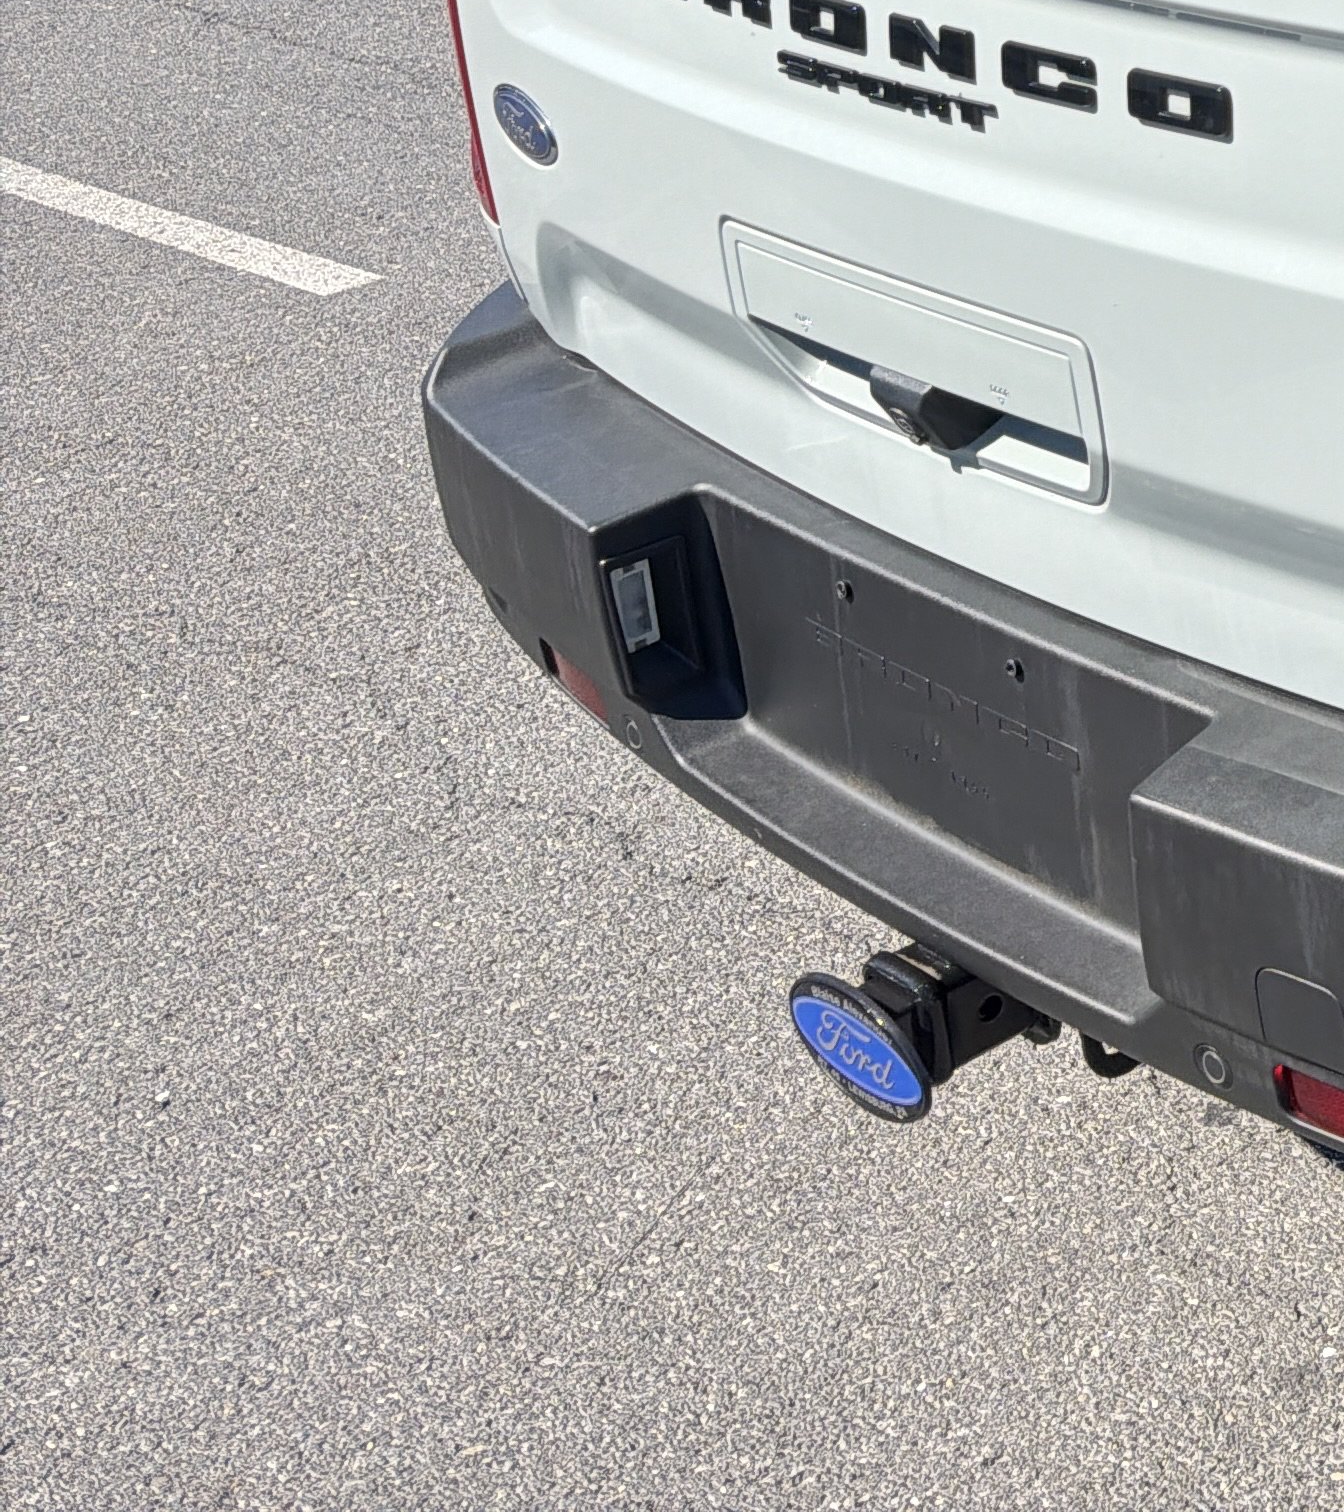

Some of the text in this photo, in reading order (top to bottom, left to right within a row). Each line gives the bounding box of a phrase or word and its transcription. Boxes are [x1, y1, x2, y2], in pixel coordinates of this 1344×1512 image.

[502, 100, 537, 151] Ford
[776, 49, 999, 134] SPORT
[816, 1009, 896, 1090] Ford
